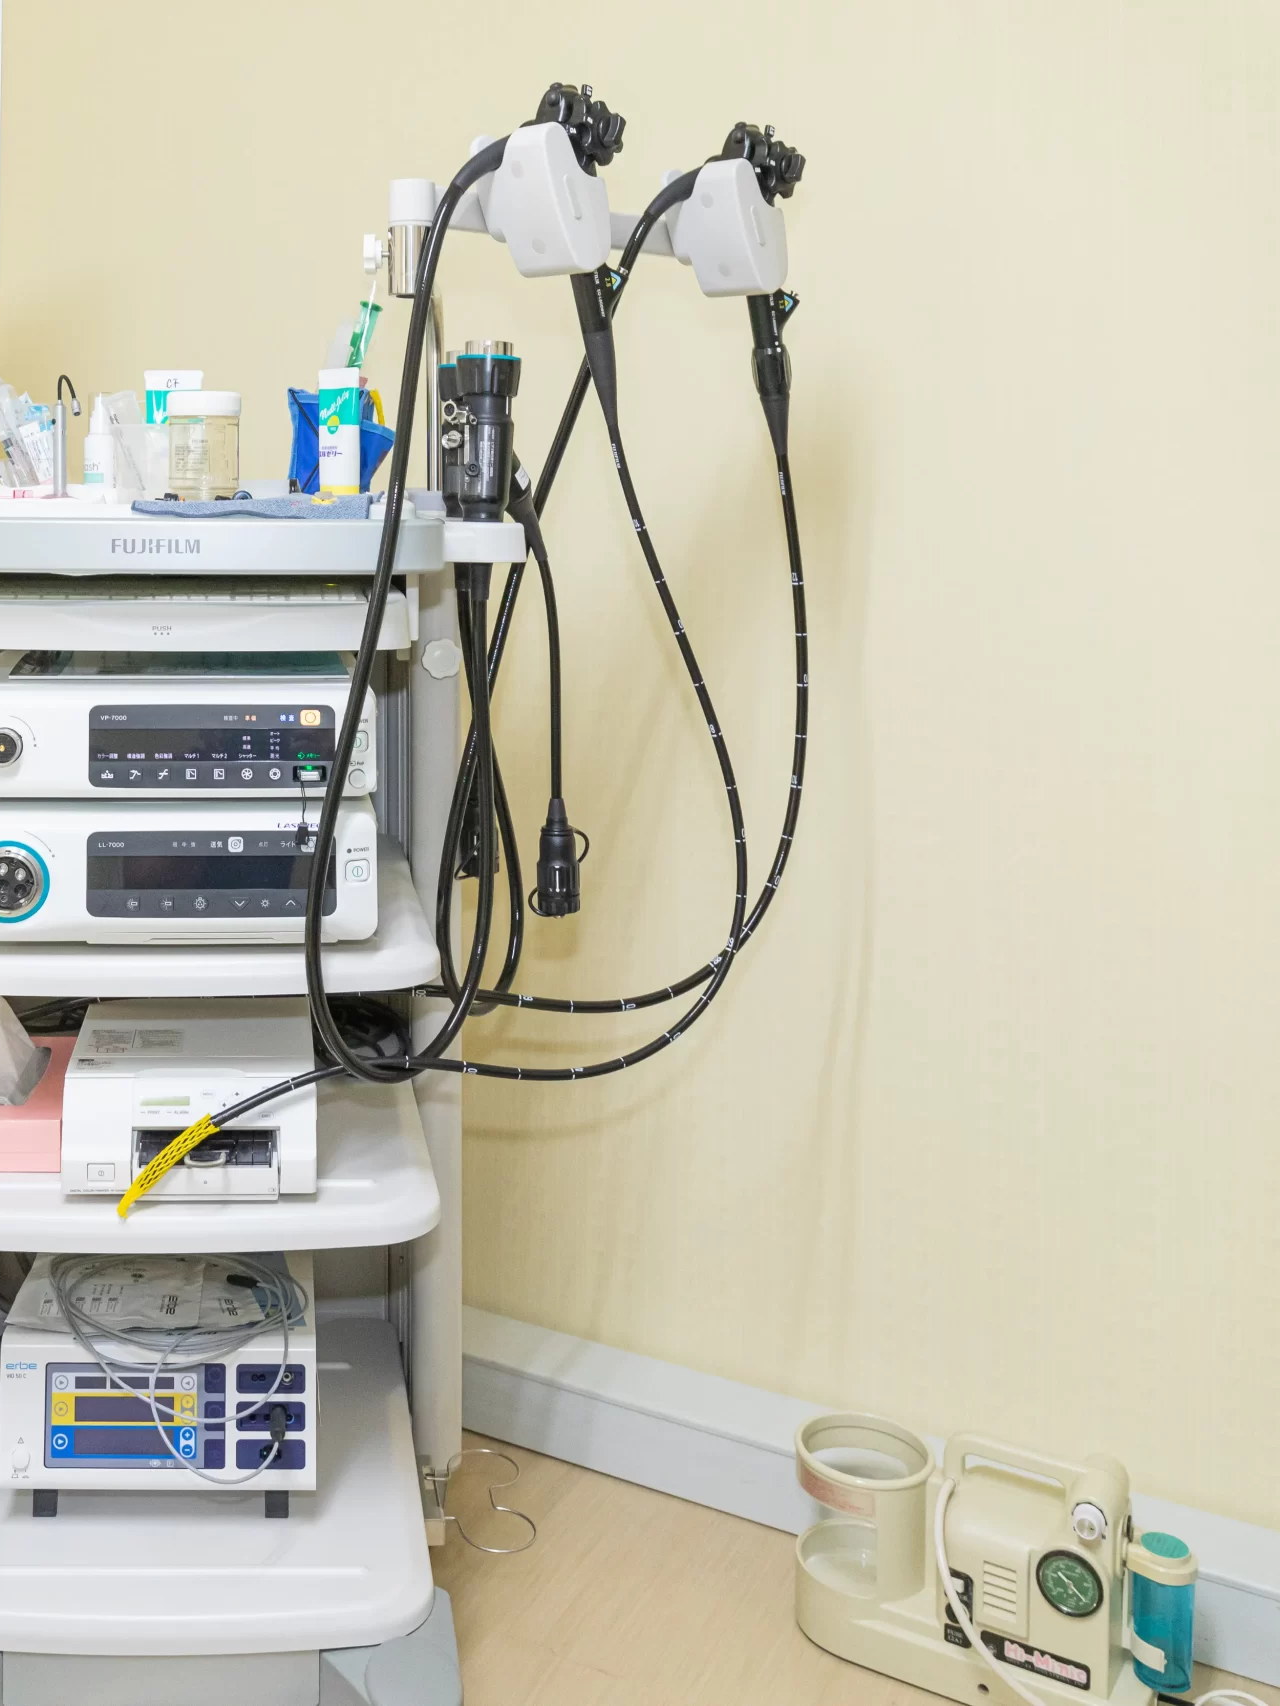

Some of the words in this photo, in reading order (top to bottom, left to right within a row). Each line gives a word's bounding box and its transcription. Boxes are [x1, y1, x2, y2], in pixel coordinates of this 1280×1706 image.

[84, 462, 99, 472] ash
[111, 538, 201, 555] FUJIFILM
[5, 1361, 37, 1370] erbe
